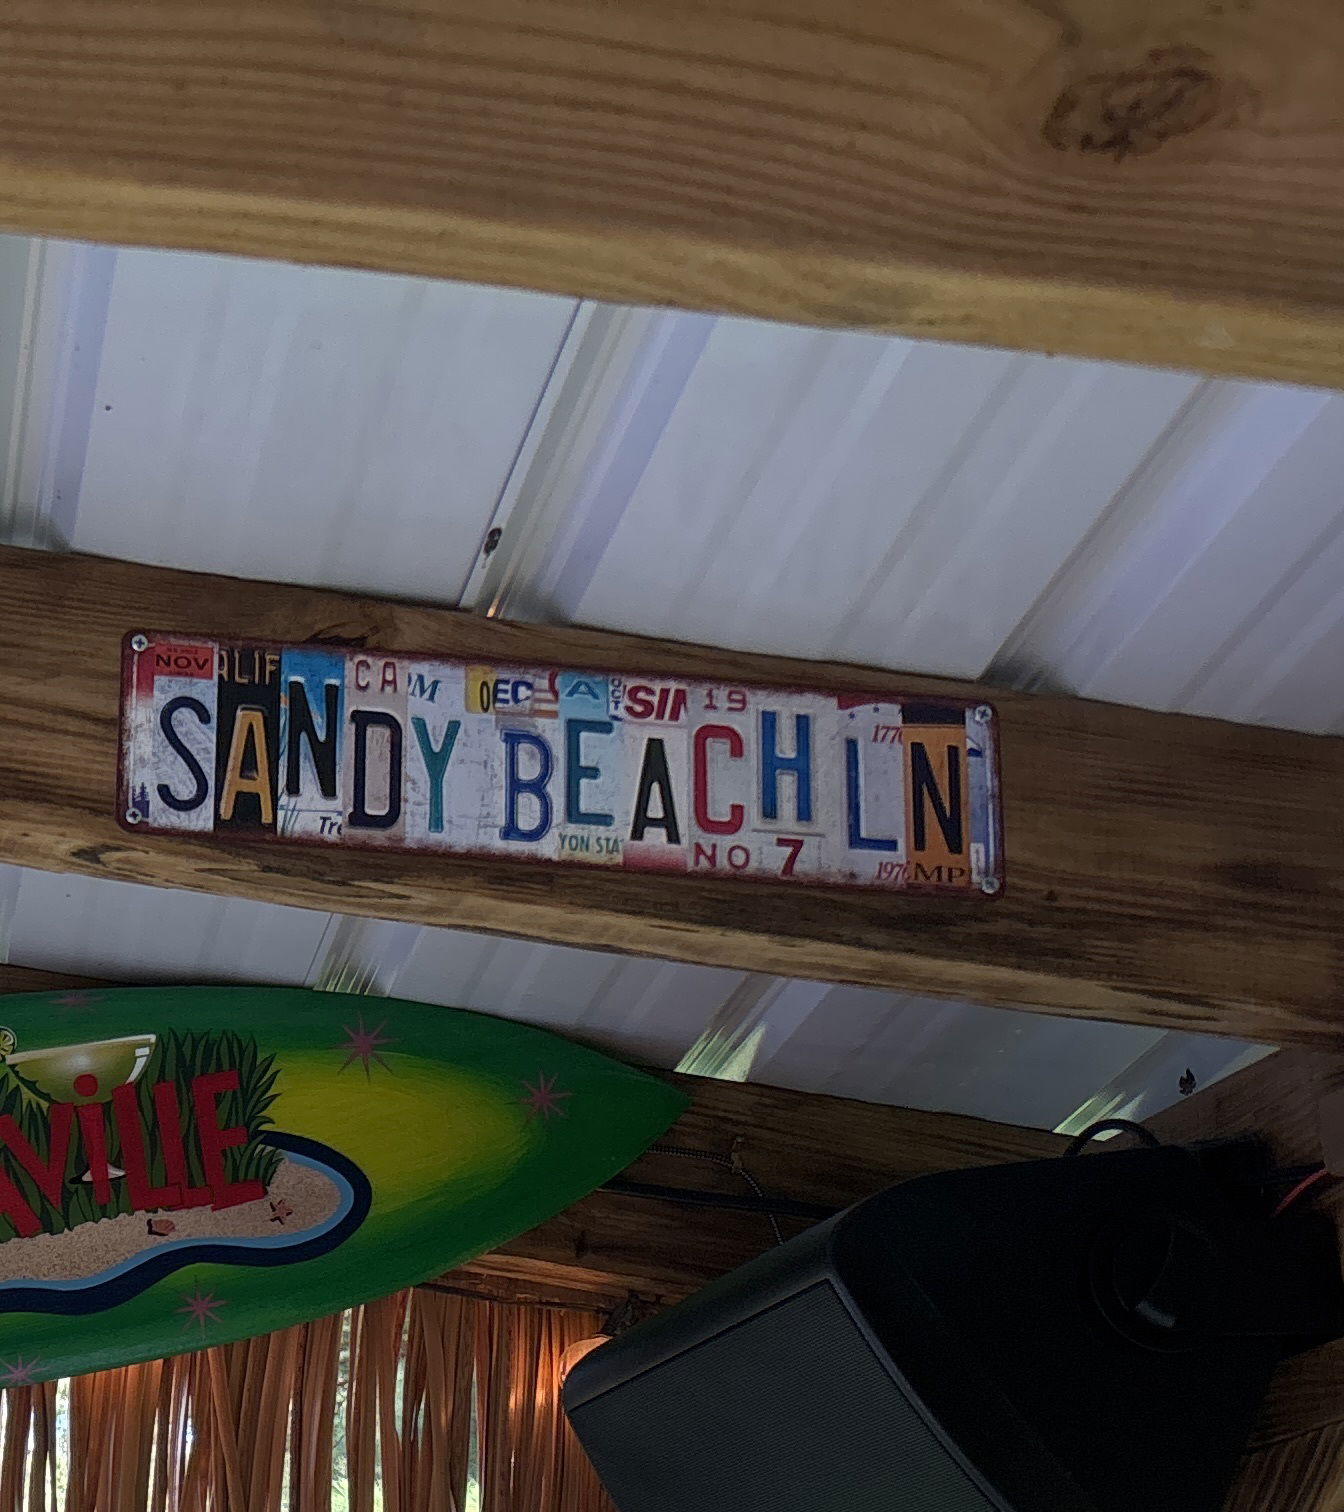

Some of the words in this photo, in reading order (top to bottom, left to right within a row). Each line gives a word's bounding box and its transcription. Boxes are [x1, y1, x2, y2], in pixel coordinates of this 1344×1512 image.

[155, 653, 210, 671] NOV
[703, 687, 748, 712] 19
[156, 680, 461, 834] SANDY
[499, 710, 813, 846] BEACH
[845, 737, 964, 856] LN
[596, 835, 624, 855] STA
[693, 842, 750, 871] NO
[775, 836, 805, 879] 7
